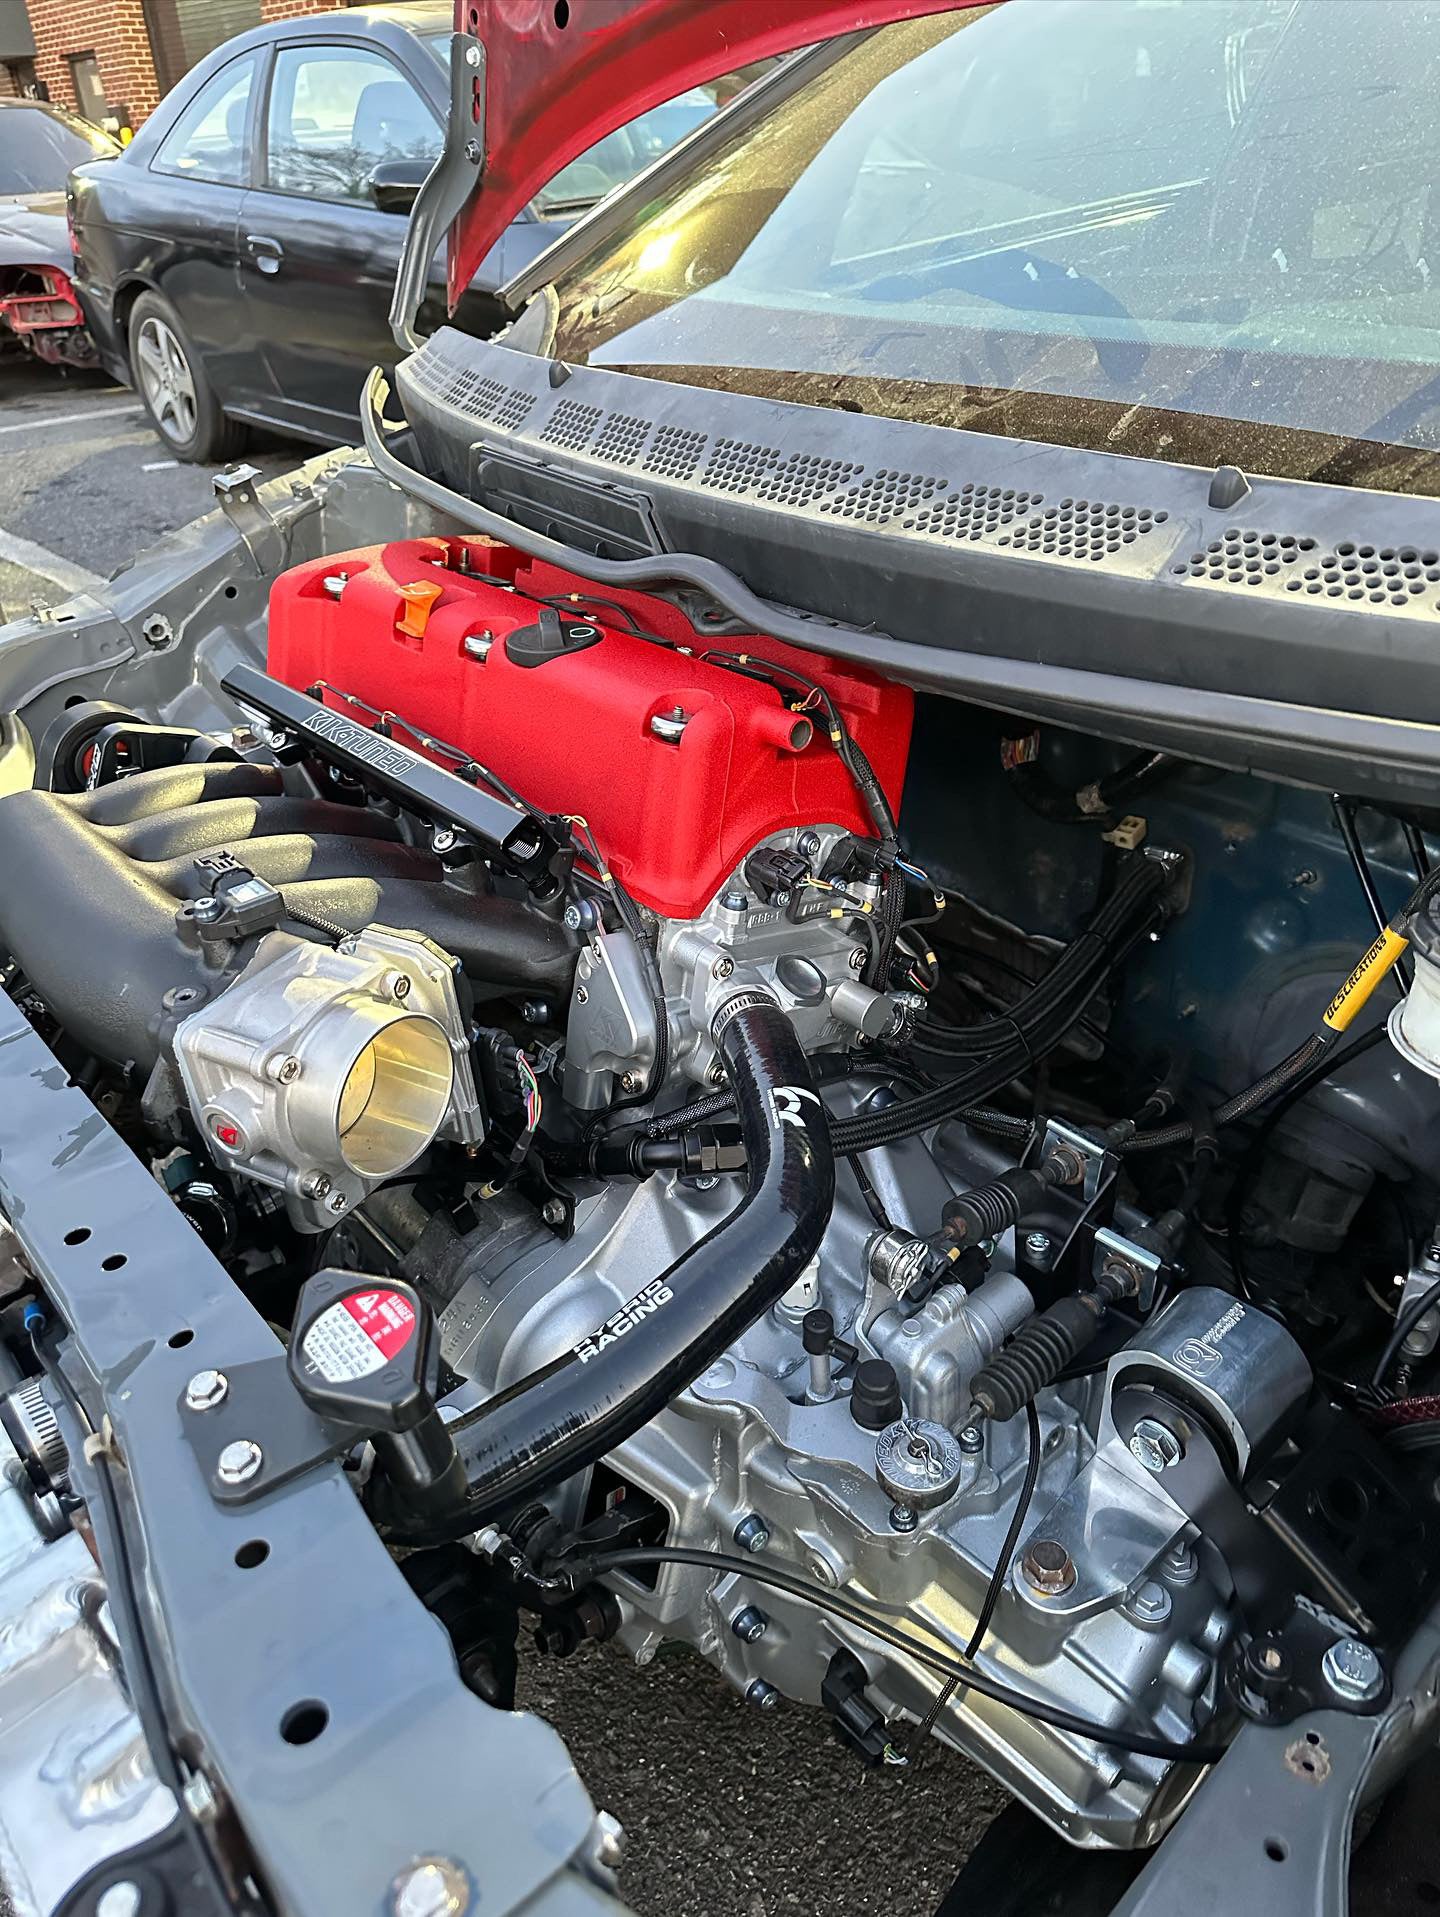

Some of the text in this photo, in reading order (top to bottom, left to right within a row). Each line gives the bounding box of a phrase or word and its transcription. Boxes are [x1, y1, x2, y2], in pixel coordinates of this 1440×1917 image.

[387, 1295, 415, 1322] DANGER
[573, 1279, 664, 1353] HYBRID
[577, 1286, 674, 1364] RACING
